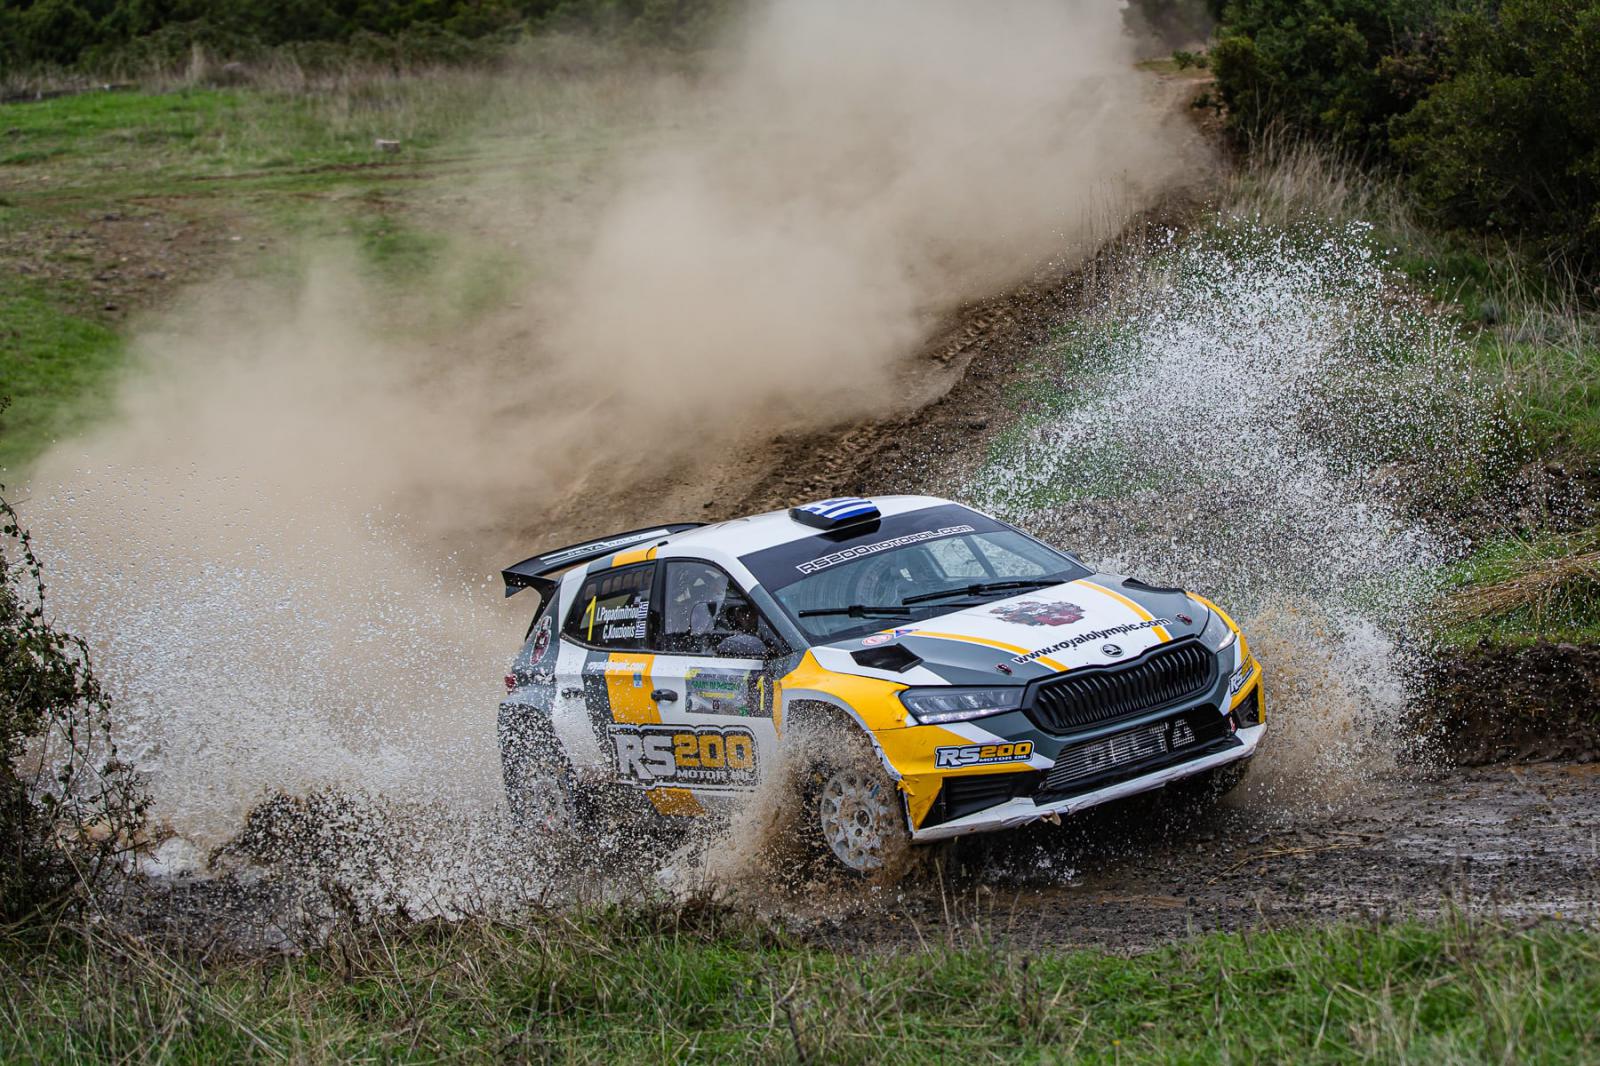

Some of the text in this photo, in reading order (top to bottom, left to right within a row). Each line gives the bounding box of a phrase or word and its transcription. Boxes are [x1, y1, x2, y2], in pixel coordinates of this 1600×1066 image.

[586, 595, 597, 641] 1
[1013, 618, 1170, 665] www.royalolympic.com
[757, 676, 765, 712] 1
[611, 734, 752, 778] RS200
[677, 769, 725, 779] MOTOR
[938, 743, 1032, 766] RS200
